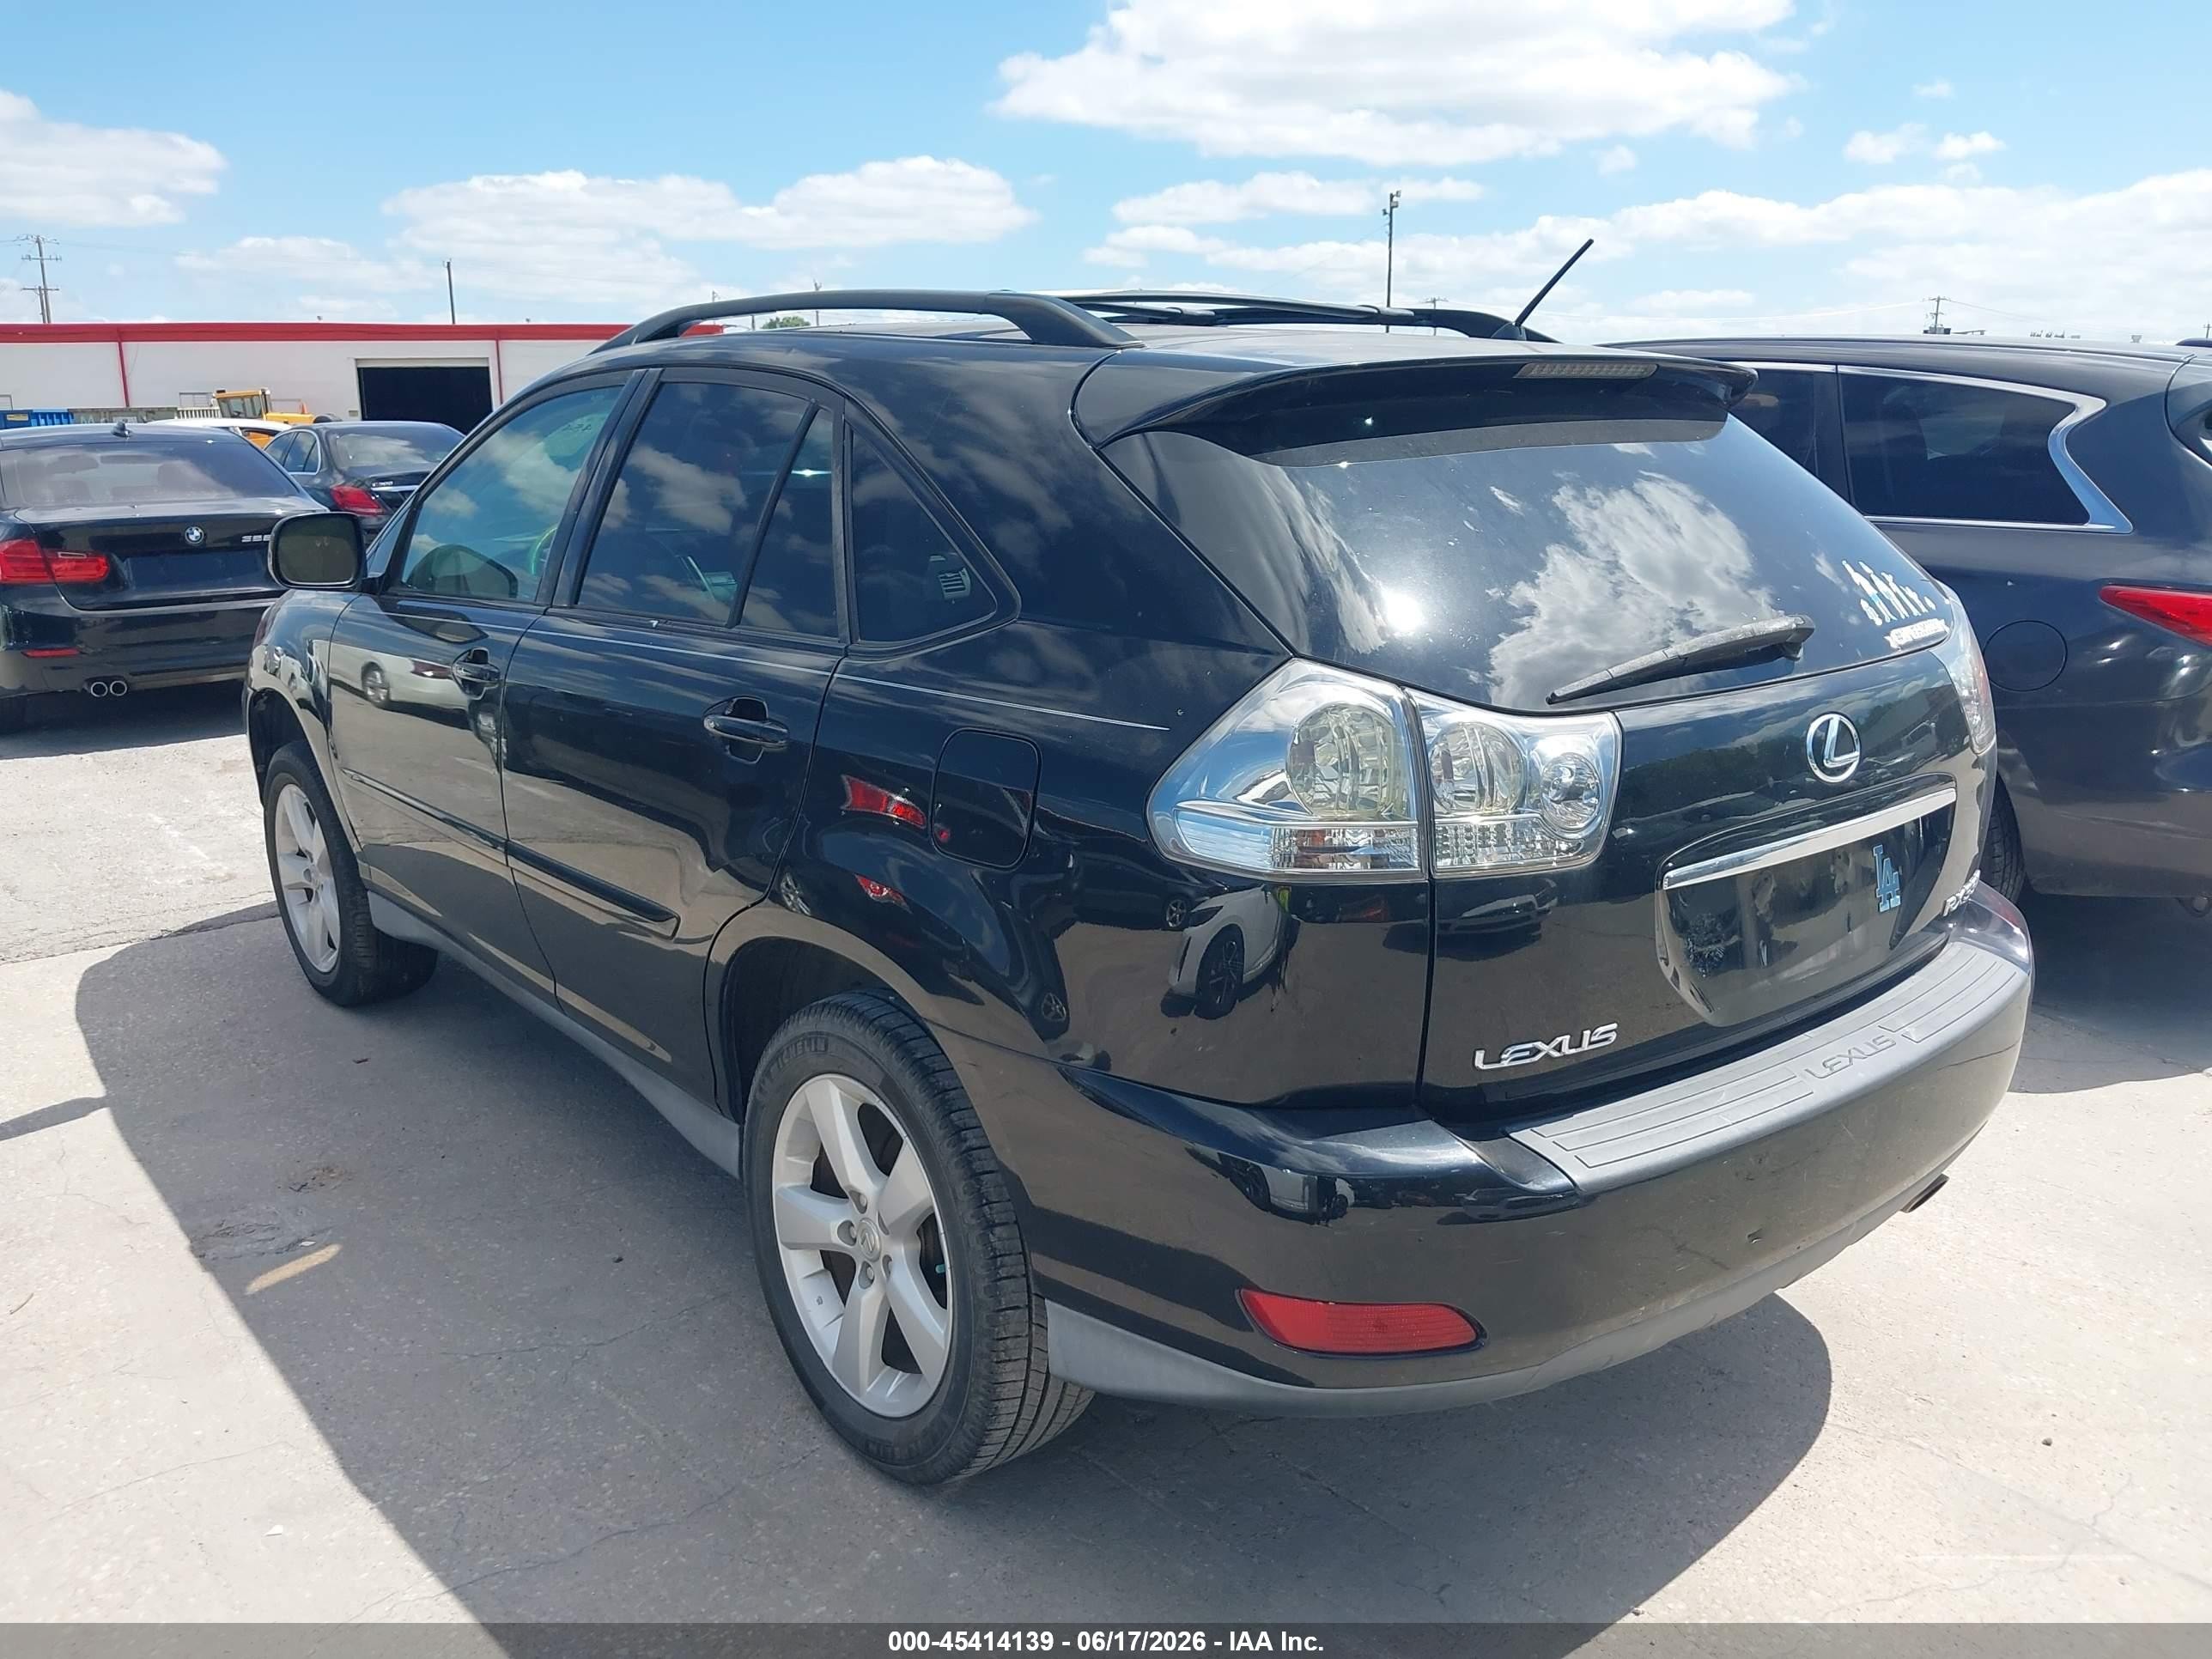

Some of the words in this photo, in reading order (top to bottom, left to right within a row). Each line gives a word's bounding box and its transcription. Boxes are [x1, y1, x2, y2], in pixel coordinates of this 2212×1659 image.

[1873, 844, 1901, 912] LA
[1474, 1023, 1618, 1070] LEXUS
[1804, 1035, 1897, 1079] LEXUS
